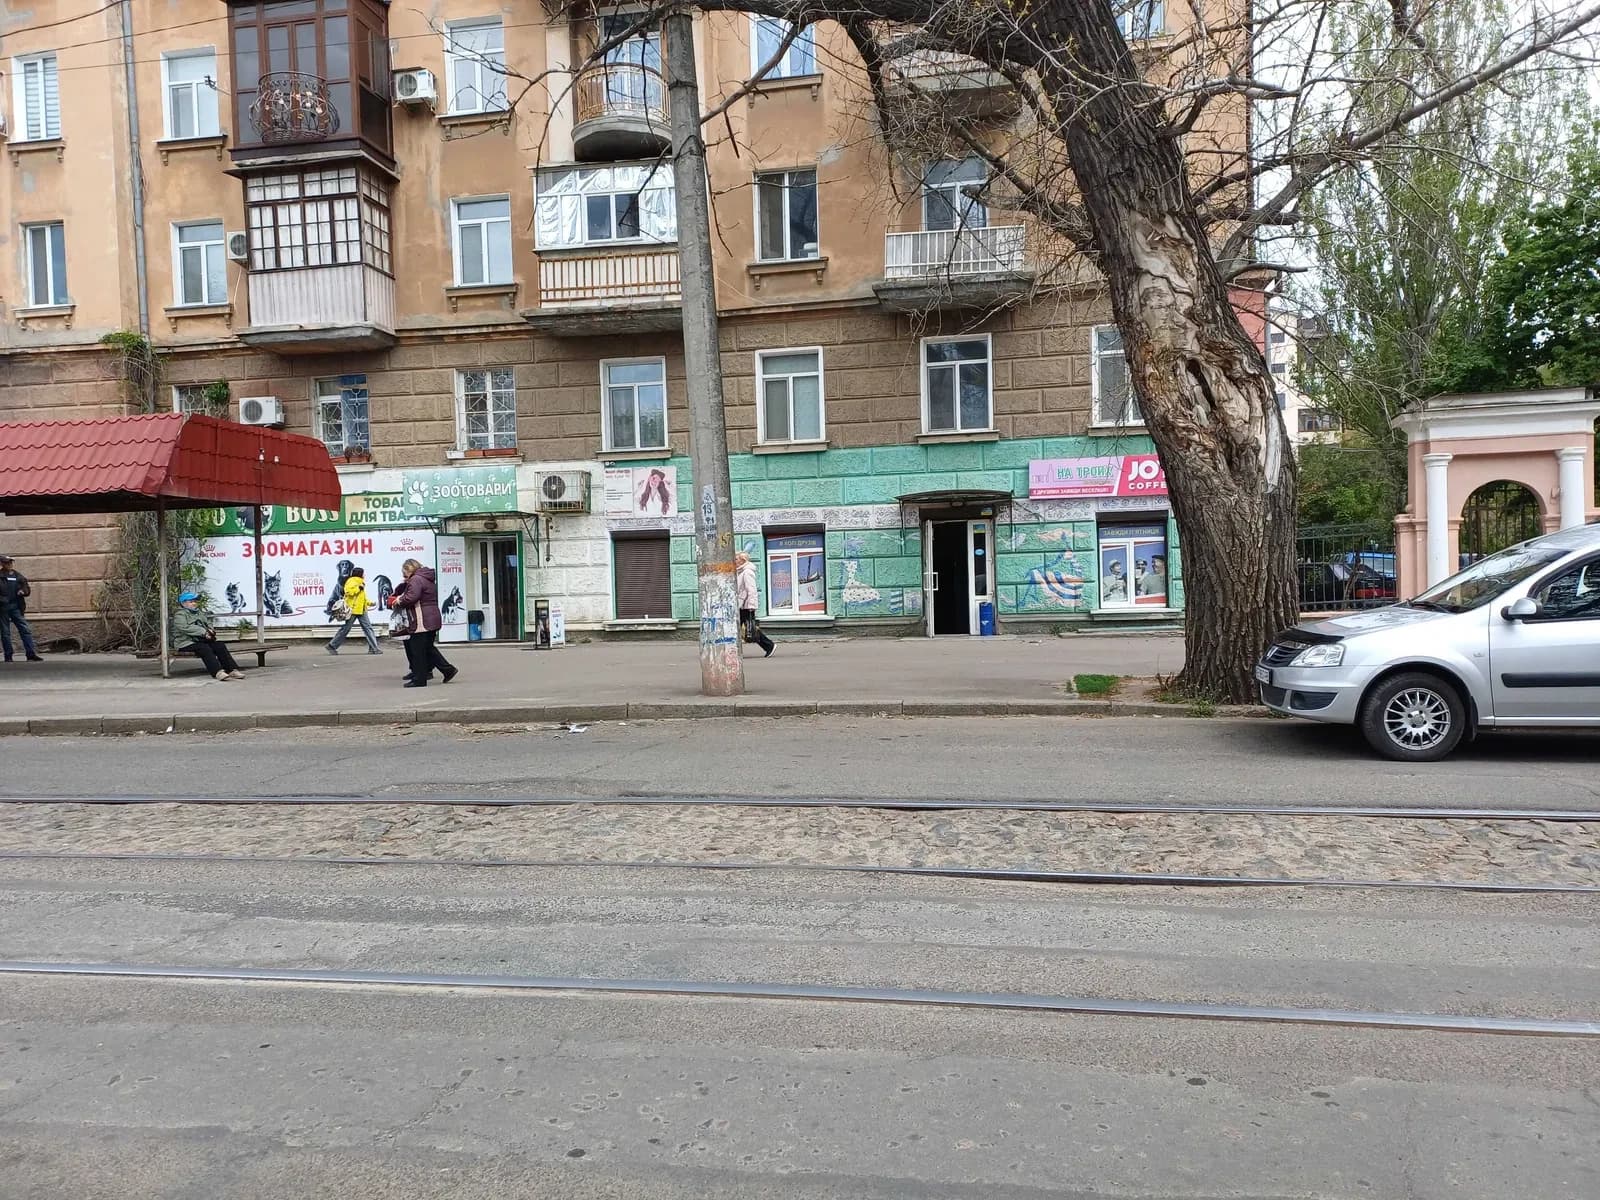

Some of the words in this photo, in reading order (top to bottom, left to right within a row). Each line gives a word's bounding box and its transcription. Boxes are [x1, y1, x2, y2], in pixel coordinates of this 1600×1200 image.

[1057, 468, 1074, 479] НА
[1128, 460, 1166, 480] JO
[432, 483, 512, 498] ЗООТОВАРИ
[349, 511, 377, 525] ДЛЯ
[242, 537, 373, 558] ЗОМАГАЗИН
[293, 586, 325, 596] ЖИТТЯ
